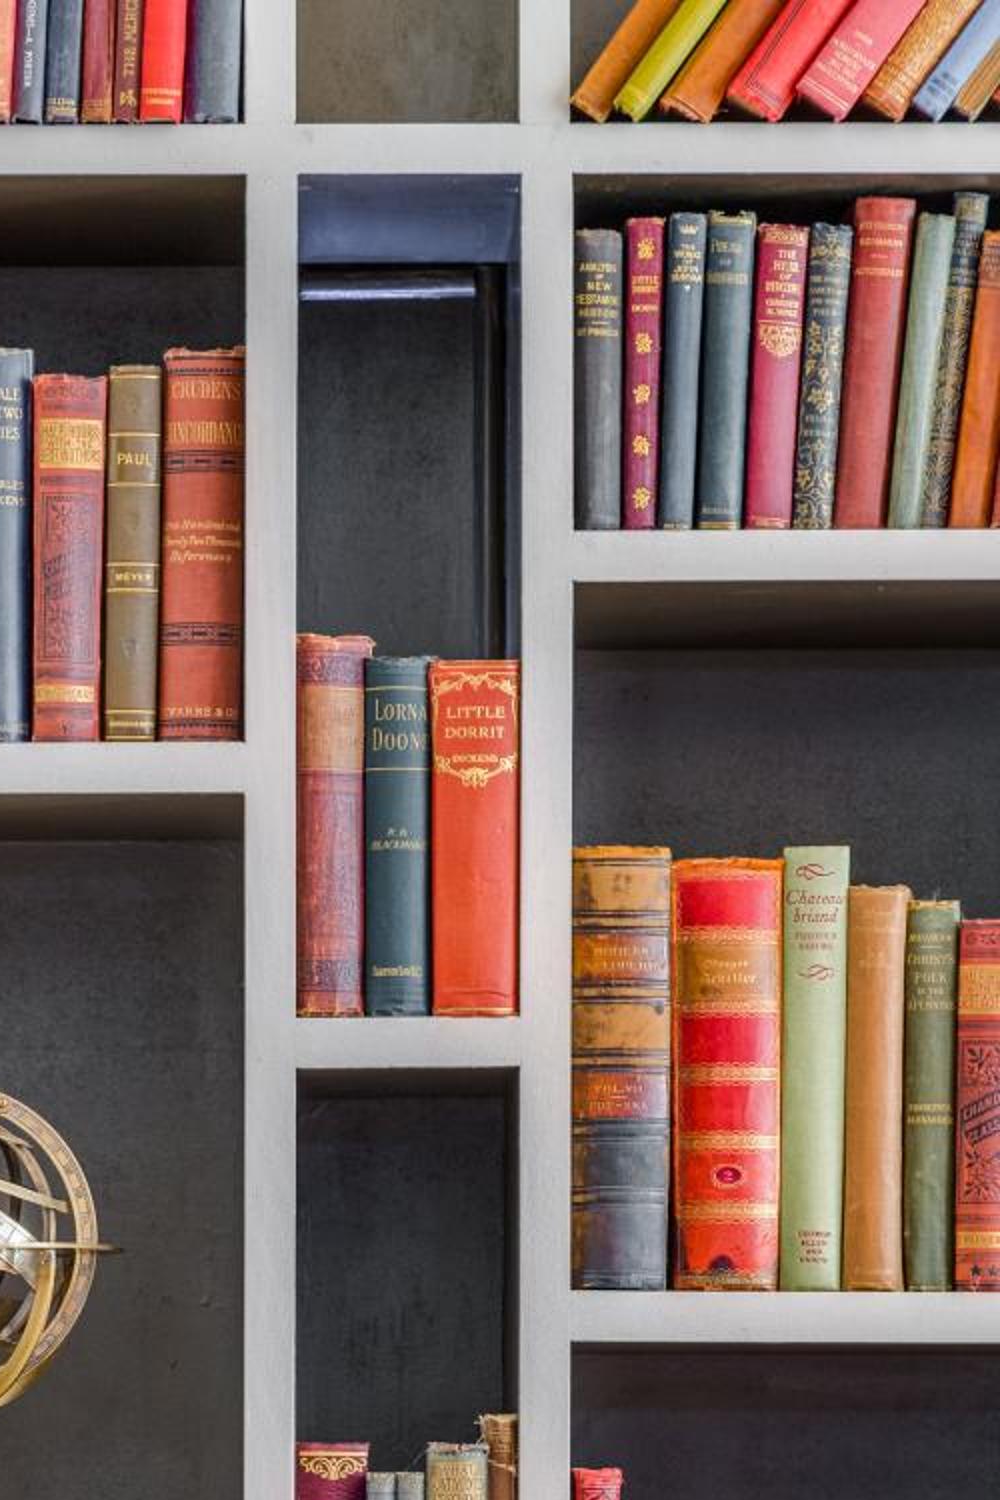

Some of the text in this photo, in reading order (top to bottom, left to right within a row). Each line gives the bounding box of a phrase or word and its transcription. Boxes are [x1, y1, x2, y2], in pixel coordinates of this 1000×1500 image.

[586, 282, 612, 291] NEW
[117, 453, 152, 464] PAUL
[375, 698, 427, 721] LORNA
[446, 705, 505, 719] LITTLE
[445, 726, 505, 739] DORRIT
[793, 908, 838, 924] briand
